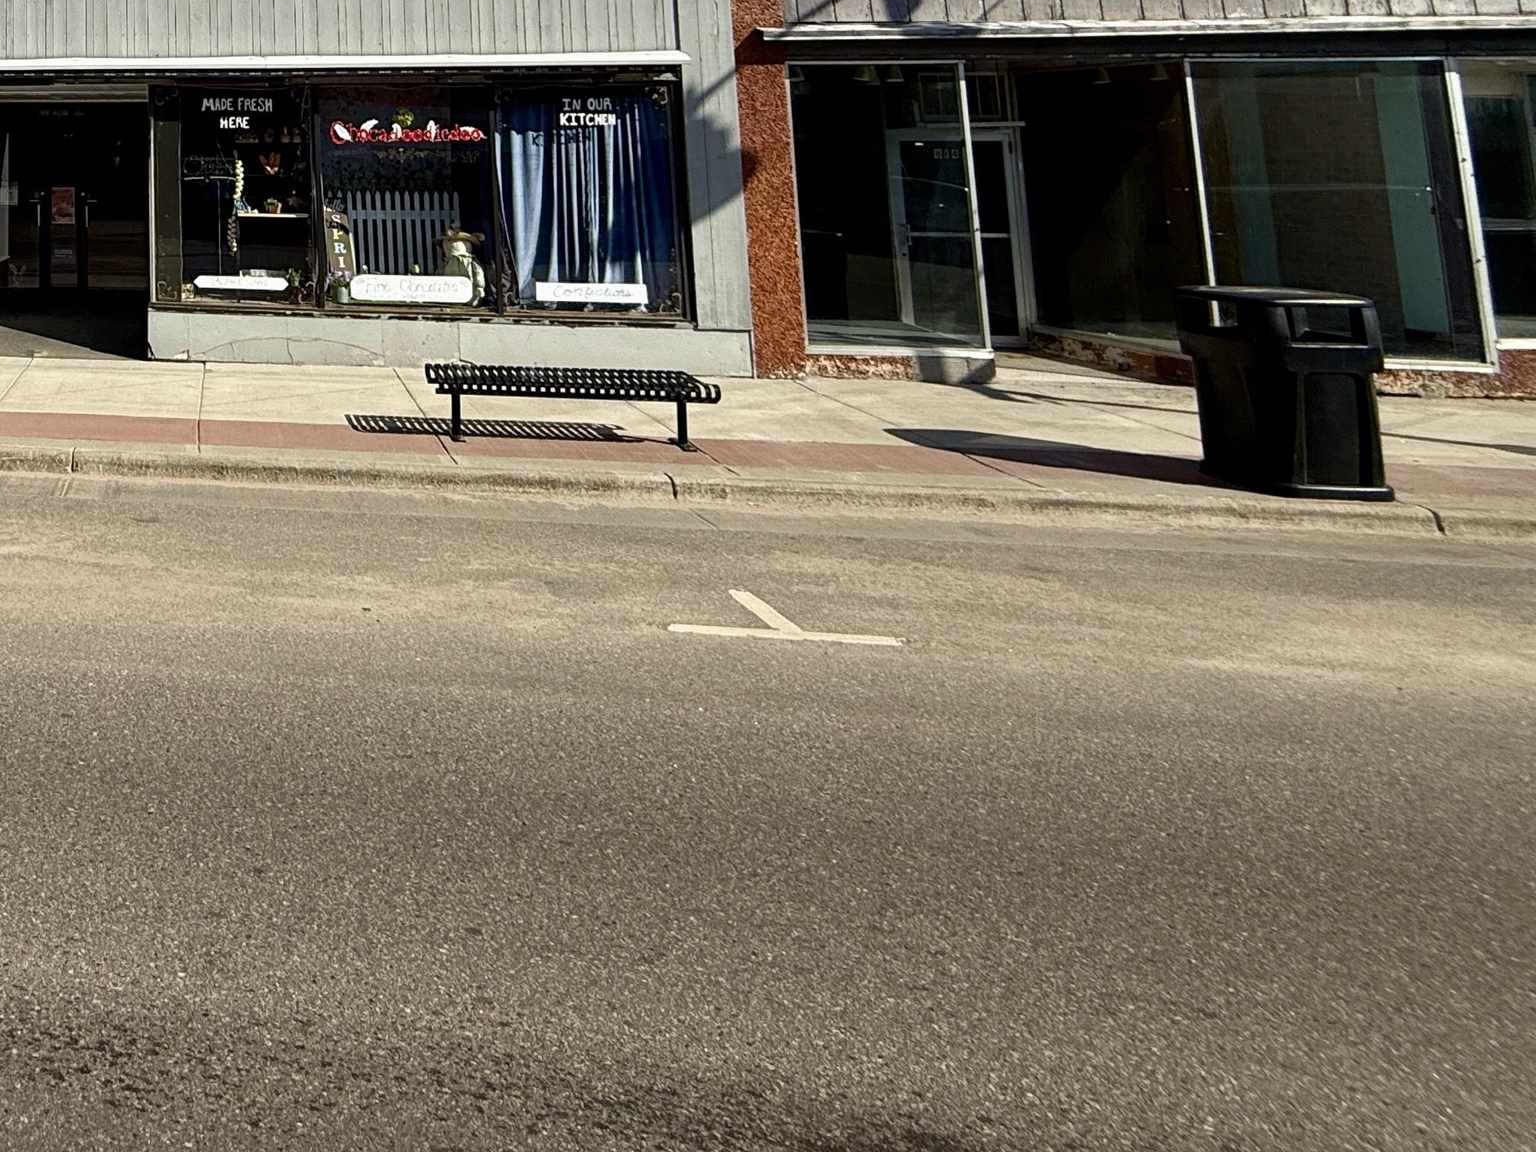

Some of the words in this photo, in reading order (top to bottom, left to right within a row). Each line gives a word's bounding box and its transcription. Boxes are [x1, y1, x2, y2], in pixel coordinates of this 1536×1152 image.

[201, 97, 234, 112] MADE
[237, 97, 273, 112] FRESH
[562, 98, 581, 111] IN
[587, 97, 613, 111] OUR
[219, 116, 250, 129] HERE
[559, 112, 616, 126] KITCHEN
